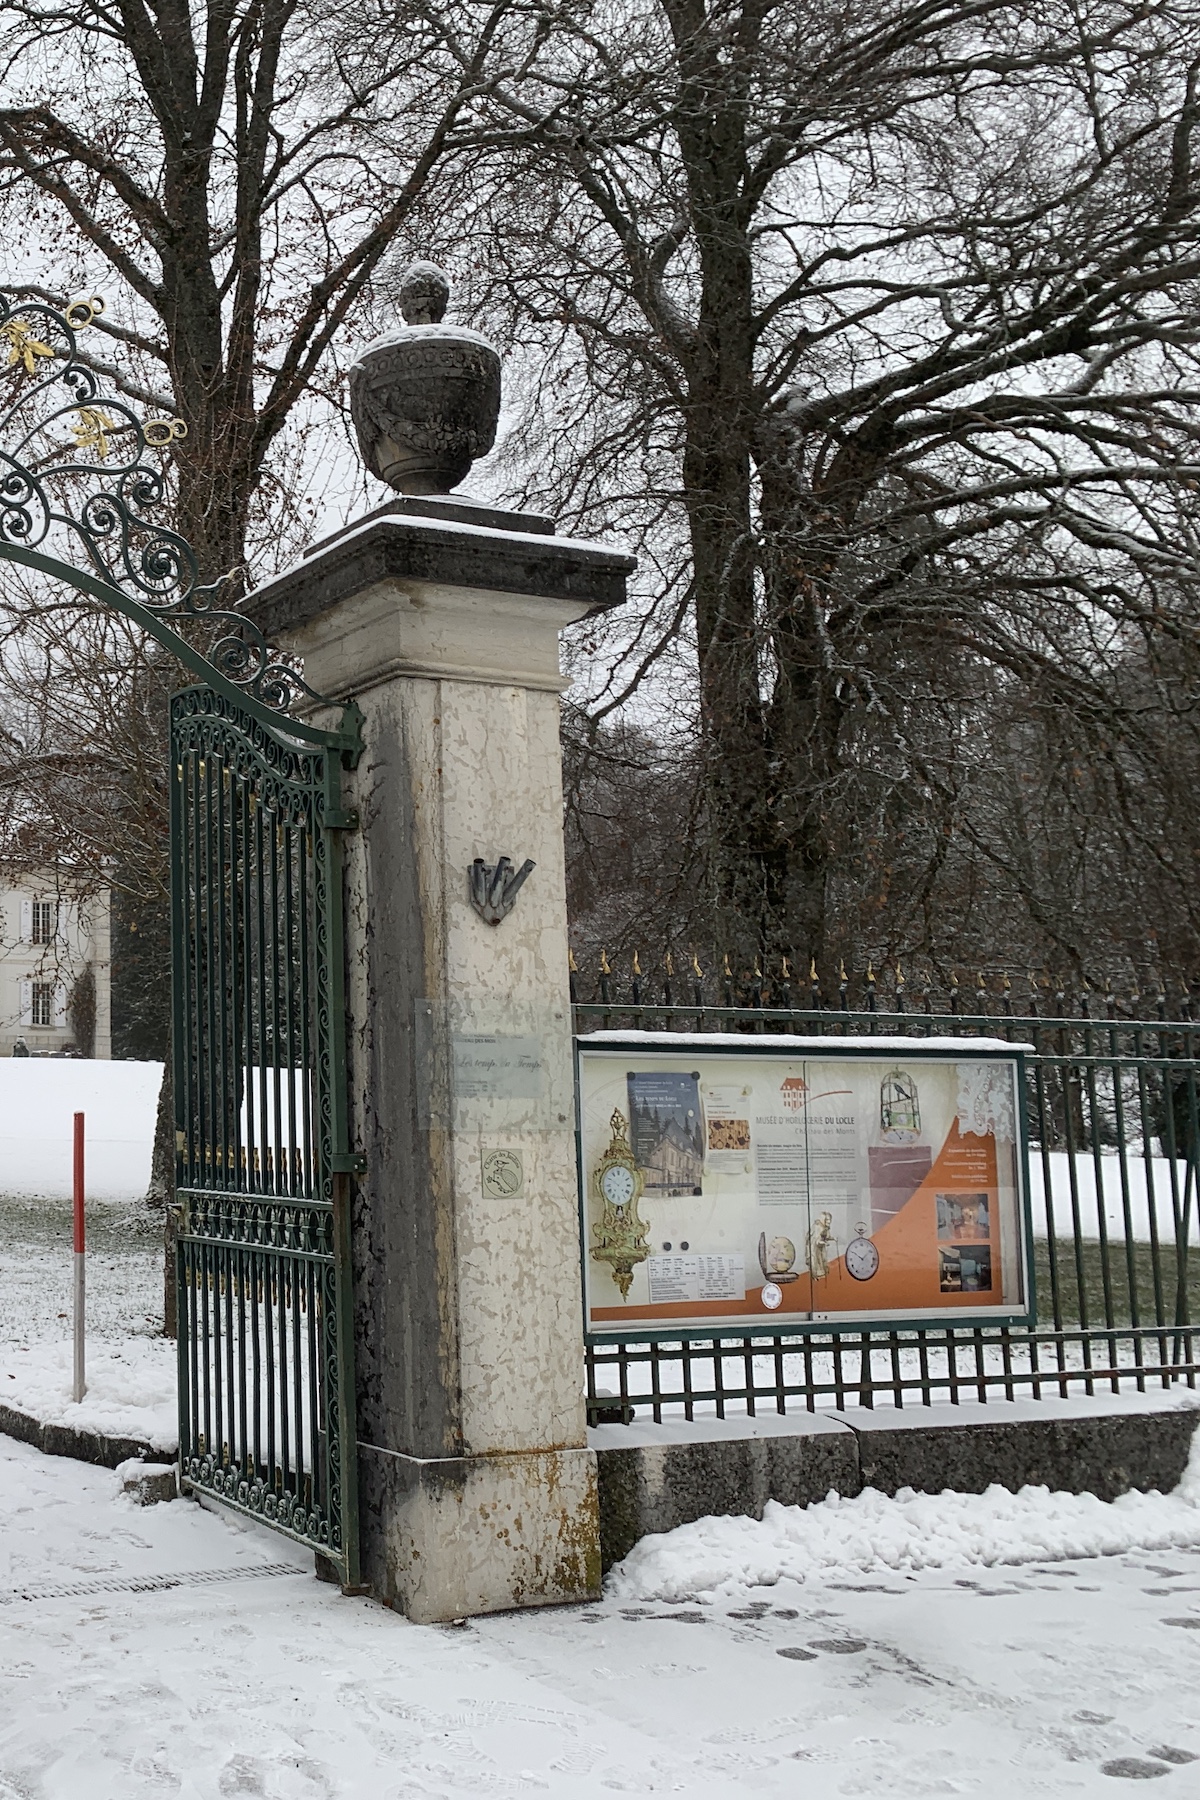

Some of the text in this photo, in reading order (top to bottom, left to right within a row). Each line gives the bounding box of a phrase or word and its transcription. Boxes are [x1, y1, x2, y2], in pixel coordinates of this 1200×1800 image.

[756, 1115, 777, 1125] MUSÉE
[824, 1116, 835, 1125] DU
[835, 1116, 855, 1125] LOCLE
[836, 1127, 856, 1135] Monts
